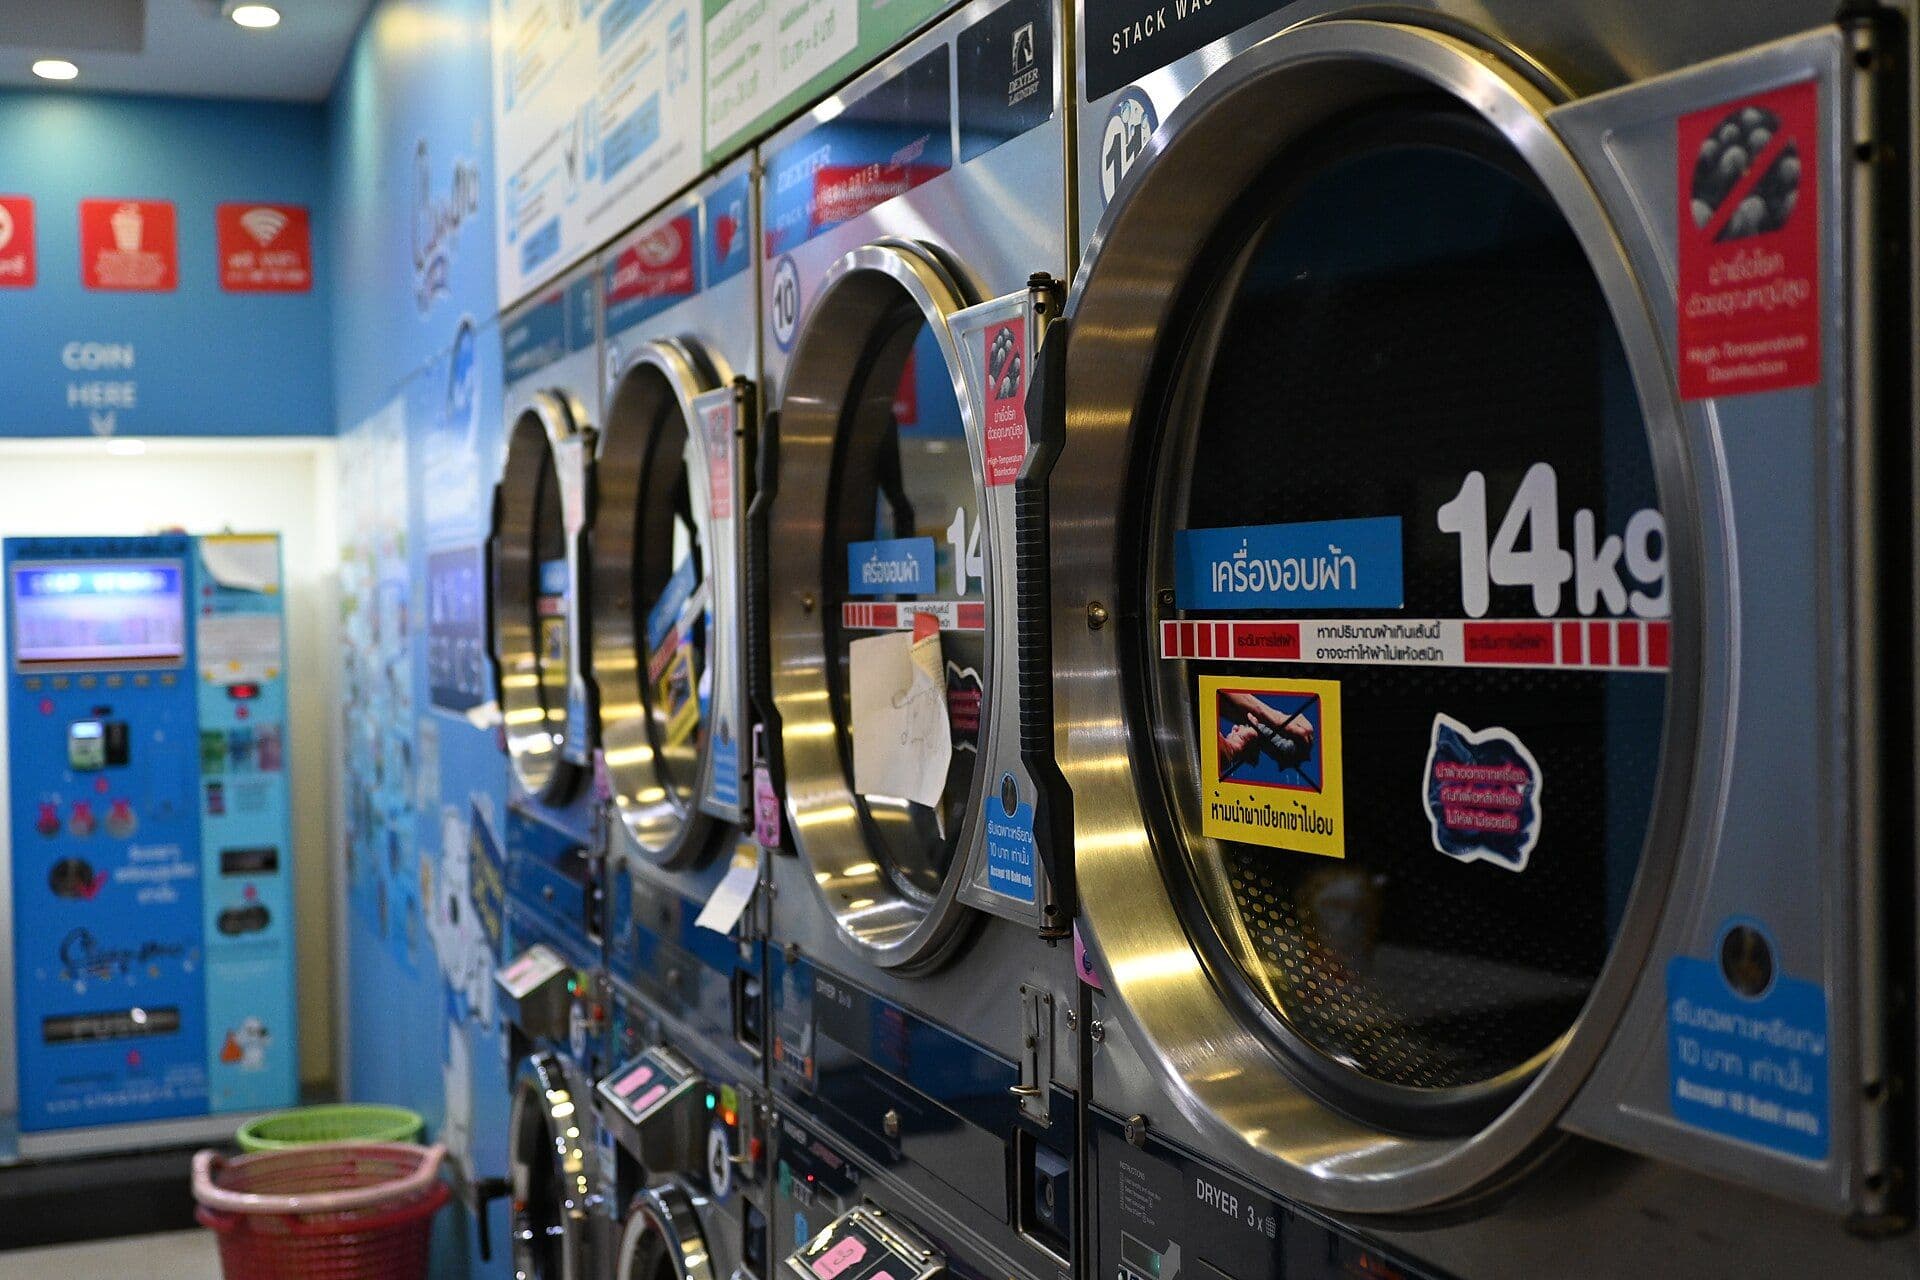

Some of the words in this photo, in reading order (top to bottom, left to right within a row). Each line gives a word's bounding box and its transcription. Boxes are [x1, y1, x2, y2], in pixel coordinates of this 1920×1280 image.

[1112, 7, 1166, 54] STACK
[1175, 0, 1213, 21] WA
[1008, 68, 1038, 94] DEXTER
[775, 278, 794, 329] 10
[62, 342, 135, 370] COIN
[66, 381, 137, 409] HERE
[1437, 462, 1671, 618] 14kg
[862, 547, 919, 584] เครื่องอบผ้า
[1211, 538, 1357, 593] เครื่องอบผ้า
[1317, 621, 1440, 639] หากปริมาณผ้าเกินเส้นนี้
[1316, 643, 1444, 661] อาจจะทำให้ผ้าไม่แห้งสนิท
[1211, 790, 1334, 836] ห้ามนำผ้าเปียกเข้าไปอบ
[990, 842, 997, 857] 10
[998, 846, 1009, 860] บาท
[1011, 846, 1030, 866] เท่านั้น
[1196, 1178, 1238, 1219] DRYER
[1247, 1205, 1254, 1227] 3
